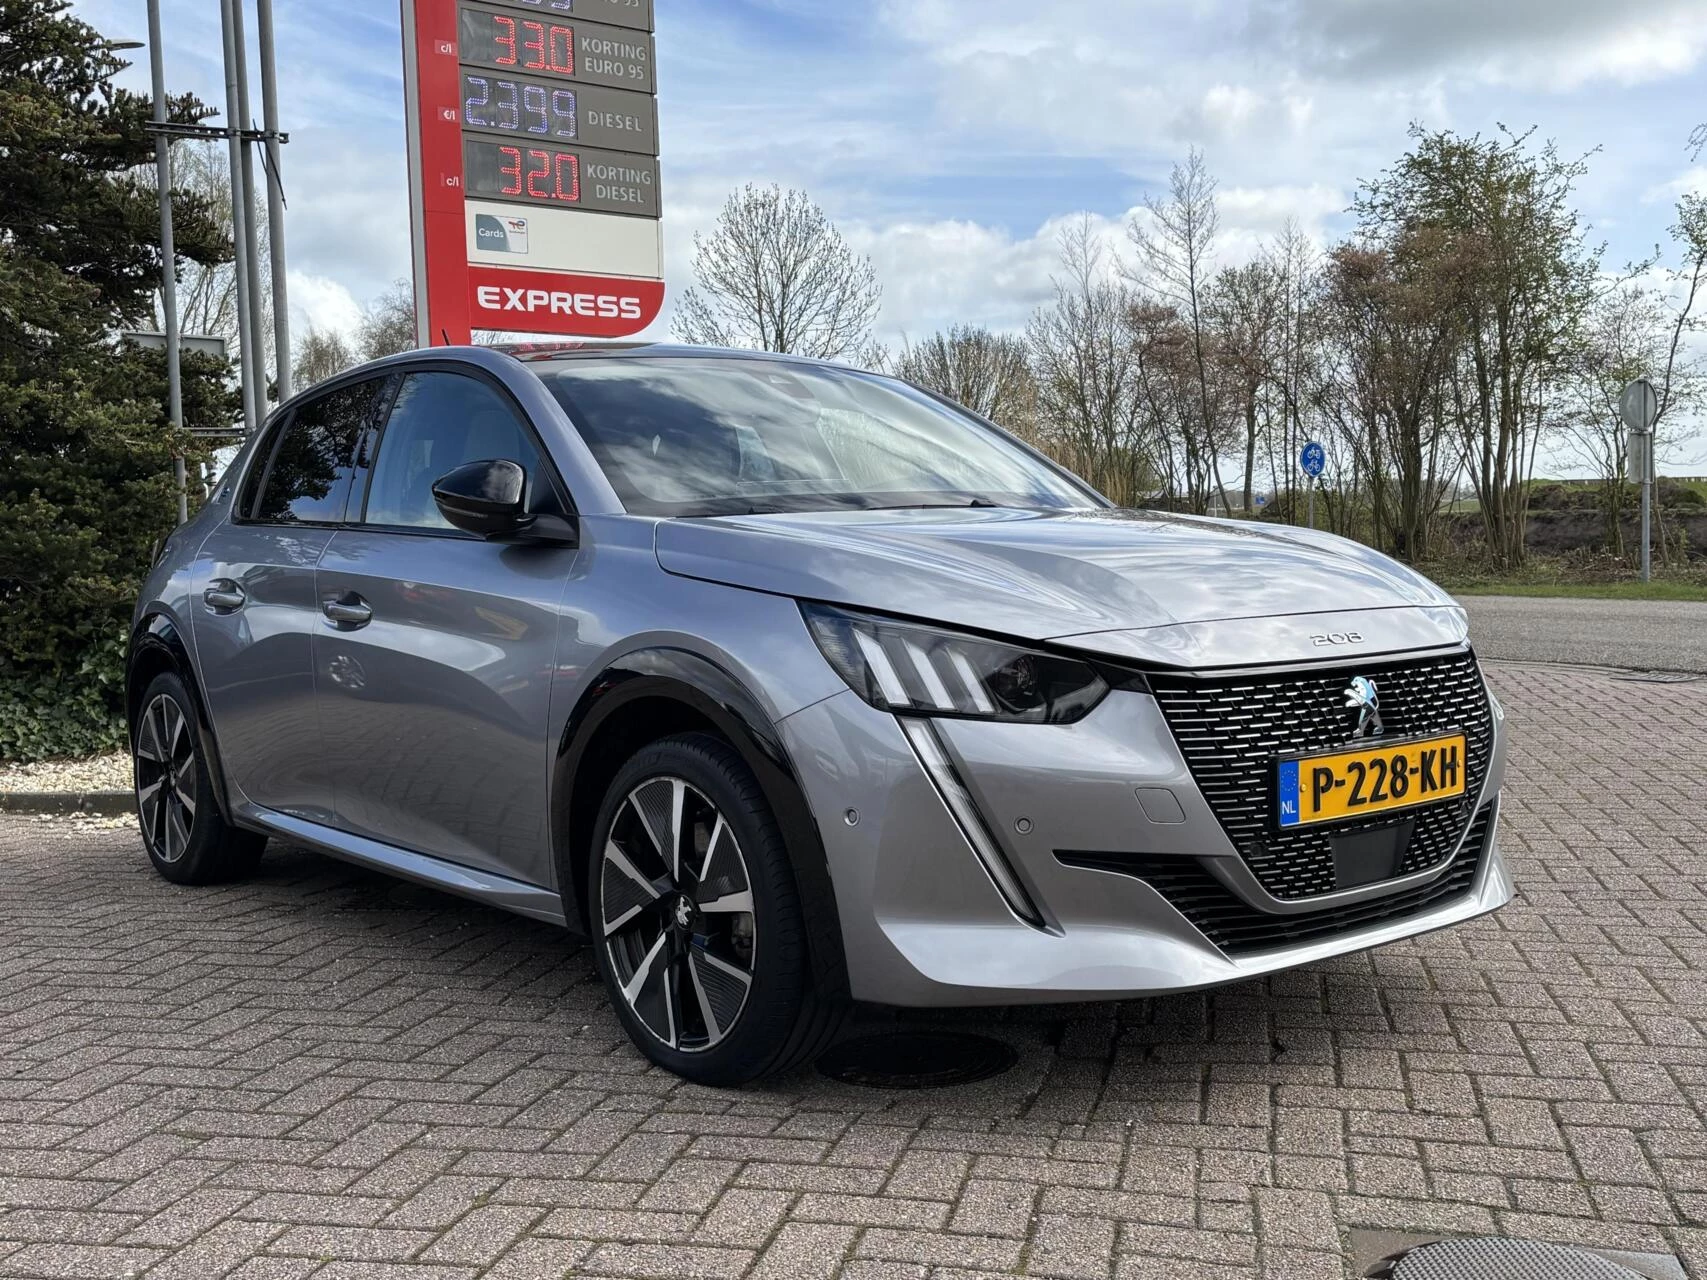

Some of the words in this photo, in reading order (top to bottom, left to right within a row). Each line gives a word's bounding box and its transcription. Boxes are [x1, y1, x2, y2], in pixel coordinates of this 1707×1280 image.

[581, 37, 647, 61] KORTING
[584, 57, 625, 76] EURO
[628, 64, 645, 80] 95
[588, 110, 643, 132] DIESEL
[587, 163, 651, 185] KORTING
[595, 184, 645, 203] DIESEL
[478, 227, 505, 238] Cards
[477, 285, 642, 319] EXPRESS
[1281, 800, 1297, 815] NL
[1312, 745, 1458, 813] P-228-KH
